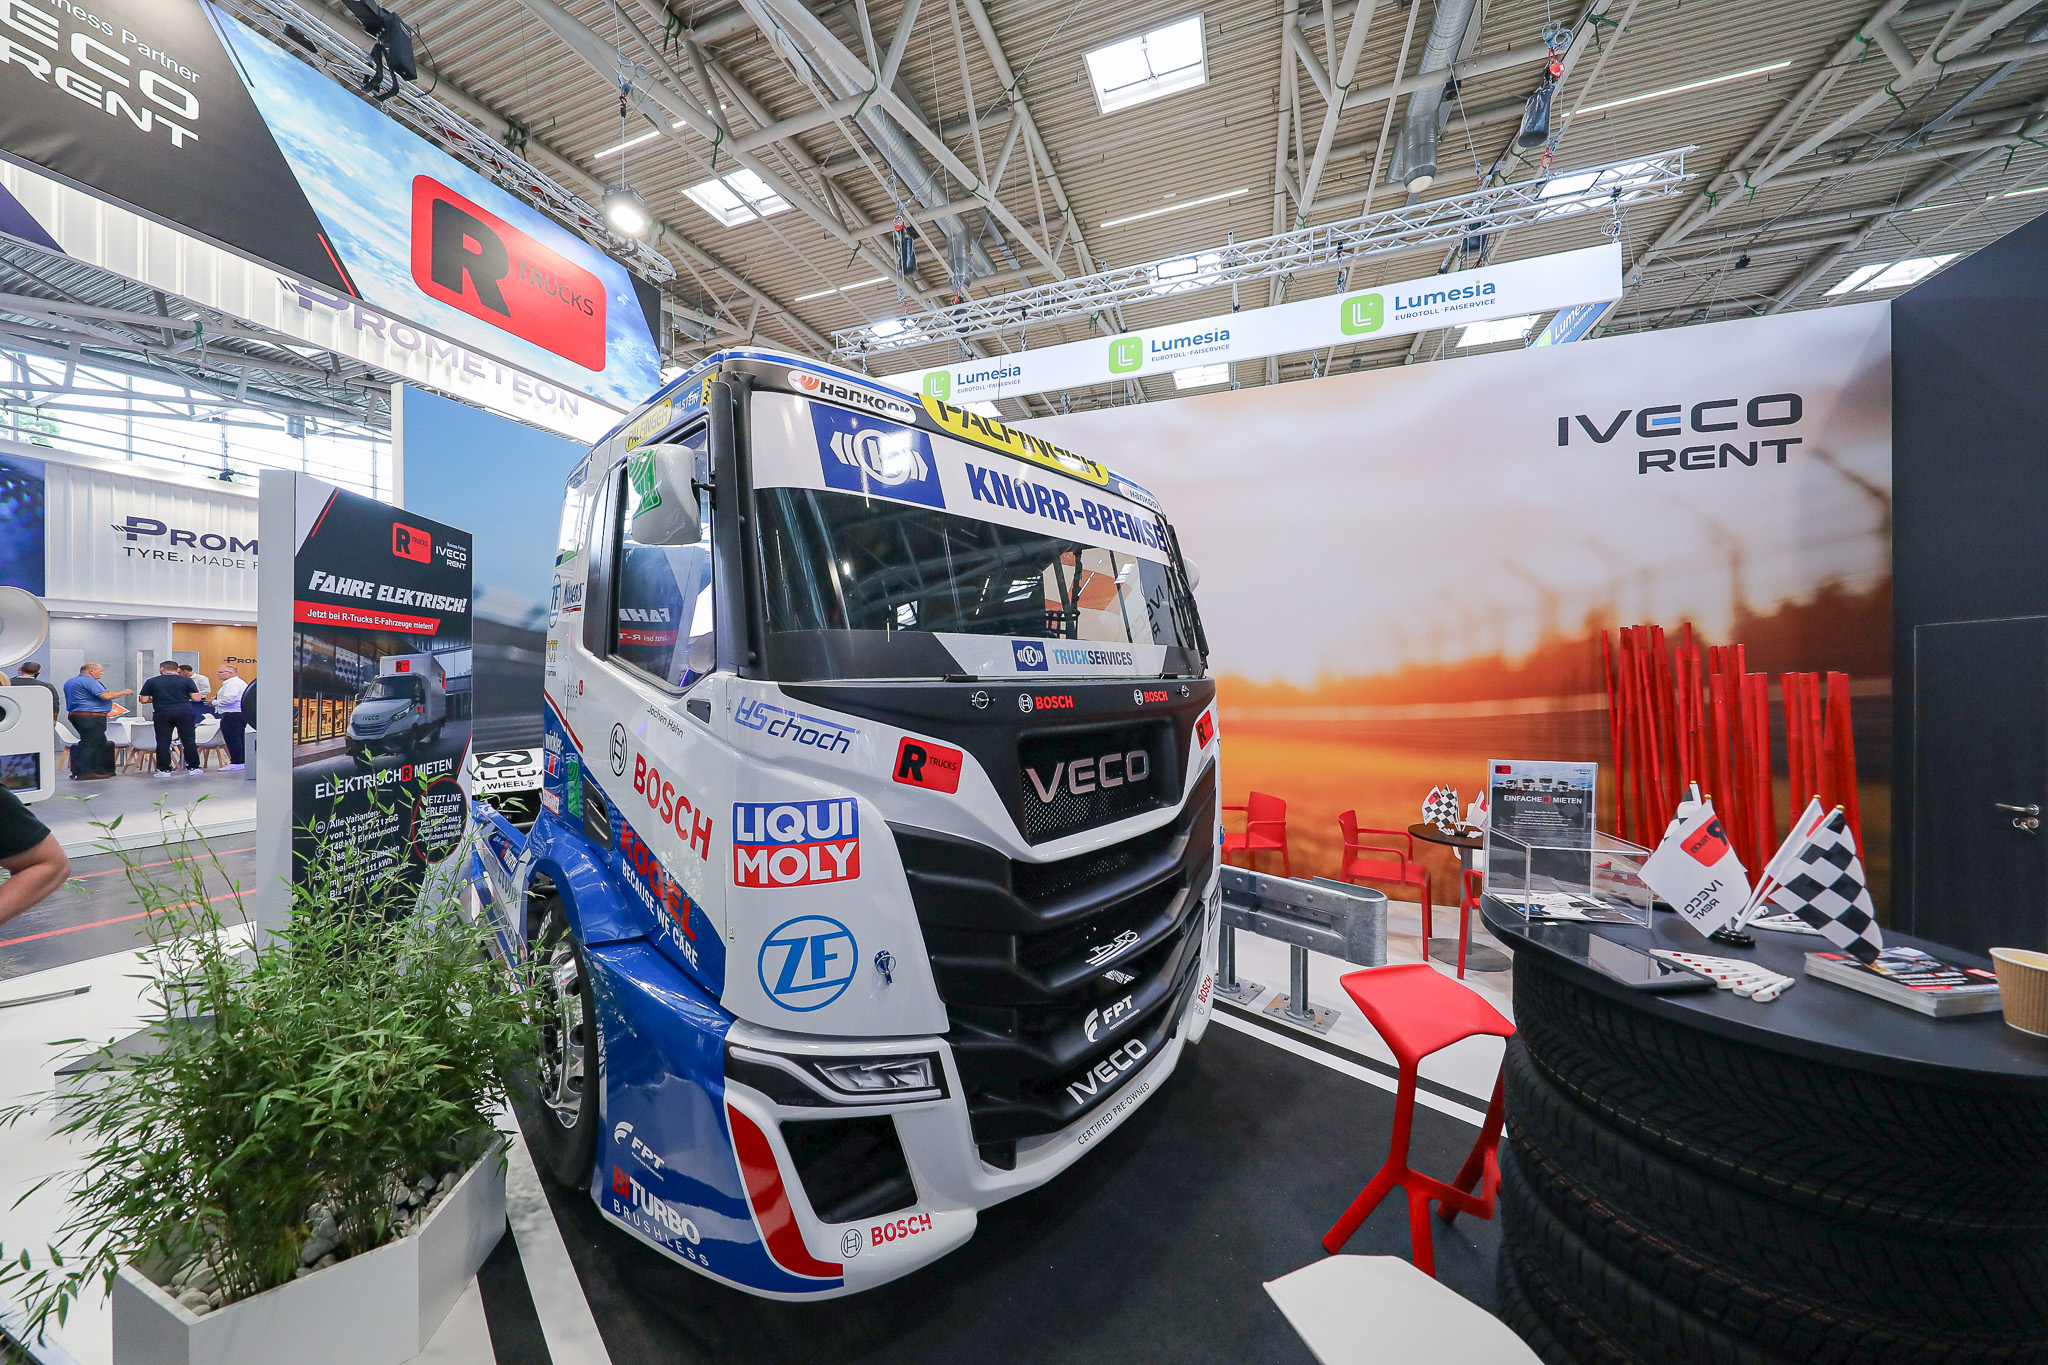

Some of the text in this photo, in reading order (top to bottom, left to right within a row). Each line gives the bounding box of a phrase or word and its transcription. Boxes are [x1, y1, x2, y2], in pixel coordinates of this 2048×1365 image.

[121, 29, 200, 83] Partner
[0, 35, 199, 149] RENT
[431, 198, 594, 318] R TRUCKS
[1395, 280, 1496, 311] Lumesia
[293, 283, 580, 416] PROMETEON
[1152, 327, 1231, 354] Lumesia
[957, 364, 1021, 386] Lumesia
[627, 403, 670, 448] PALFINGER
[1558, 392, 1803, 447] IVECO
[1638, 437, 1803, 475] RENT
[965, 462, 1168, 552] KNORR-BREMSE
[123, 546, 184, 563] TYRE.
[192, 554, 246, 570] MADE
[396, 527, 429, 555] R TRUCKS
[435, 545, 467, 562] IVECO
[446, 559, 467, 570] RENT
[308, 569, 468, 613] FAHRE ELEKTRISCH!
[307, 608, 434, 631] Jetzt bei R-Trucks E-Fahrzeuge mieten!
[1052, 648, 1133, 666] TRUCKSERVICES
[1035, 695, 1074, 710] BOSCH
[1144, 690, 1168, 703] BOSCH
[646, 704, 684, 739] Jochen Hahn
[414, 758, 453, 778] MIETEN
[897, 743, 957, 782] R TRUCKS
[425, 804, 460, 816] ERLEBEN!
[447, 793, 462, 803] LIVE
[633, 751, 713, 862] BOSCH
[1552, 796, 1583, 805] MIETEN
[329, 819, 345, 829] Alle
[329, 832, 344, 840] von
[736, 801, 854, 844] LIQUI
[737, 841, 859, 885] MOLY
[622, 857, 699, 972] BECAUSE WE CARE
[762, 925, 853, 997] ZF
[1197, 974, 1213, 1004] BOSCH
[1102, 994, 1132, 1025] FPT
[1066, 1038, 1148, 1106] IVECO
[1077, 1081, 1150, 1146] CERTIFIED PRE-OWNED
[631, 1136, 665, 1170] FPT
[613, 1164, 700, 1245] BITURBO
[613, 1198, 709, 1267] BRUSHLESS
[871, 1212, 933, 1247] BOSCH
